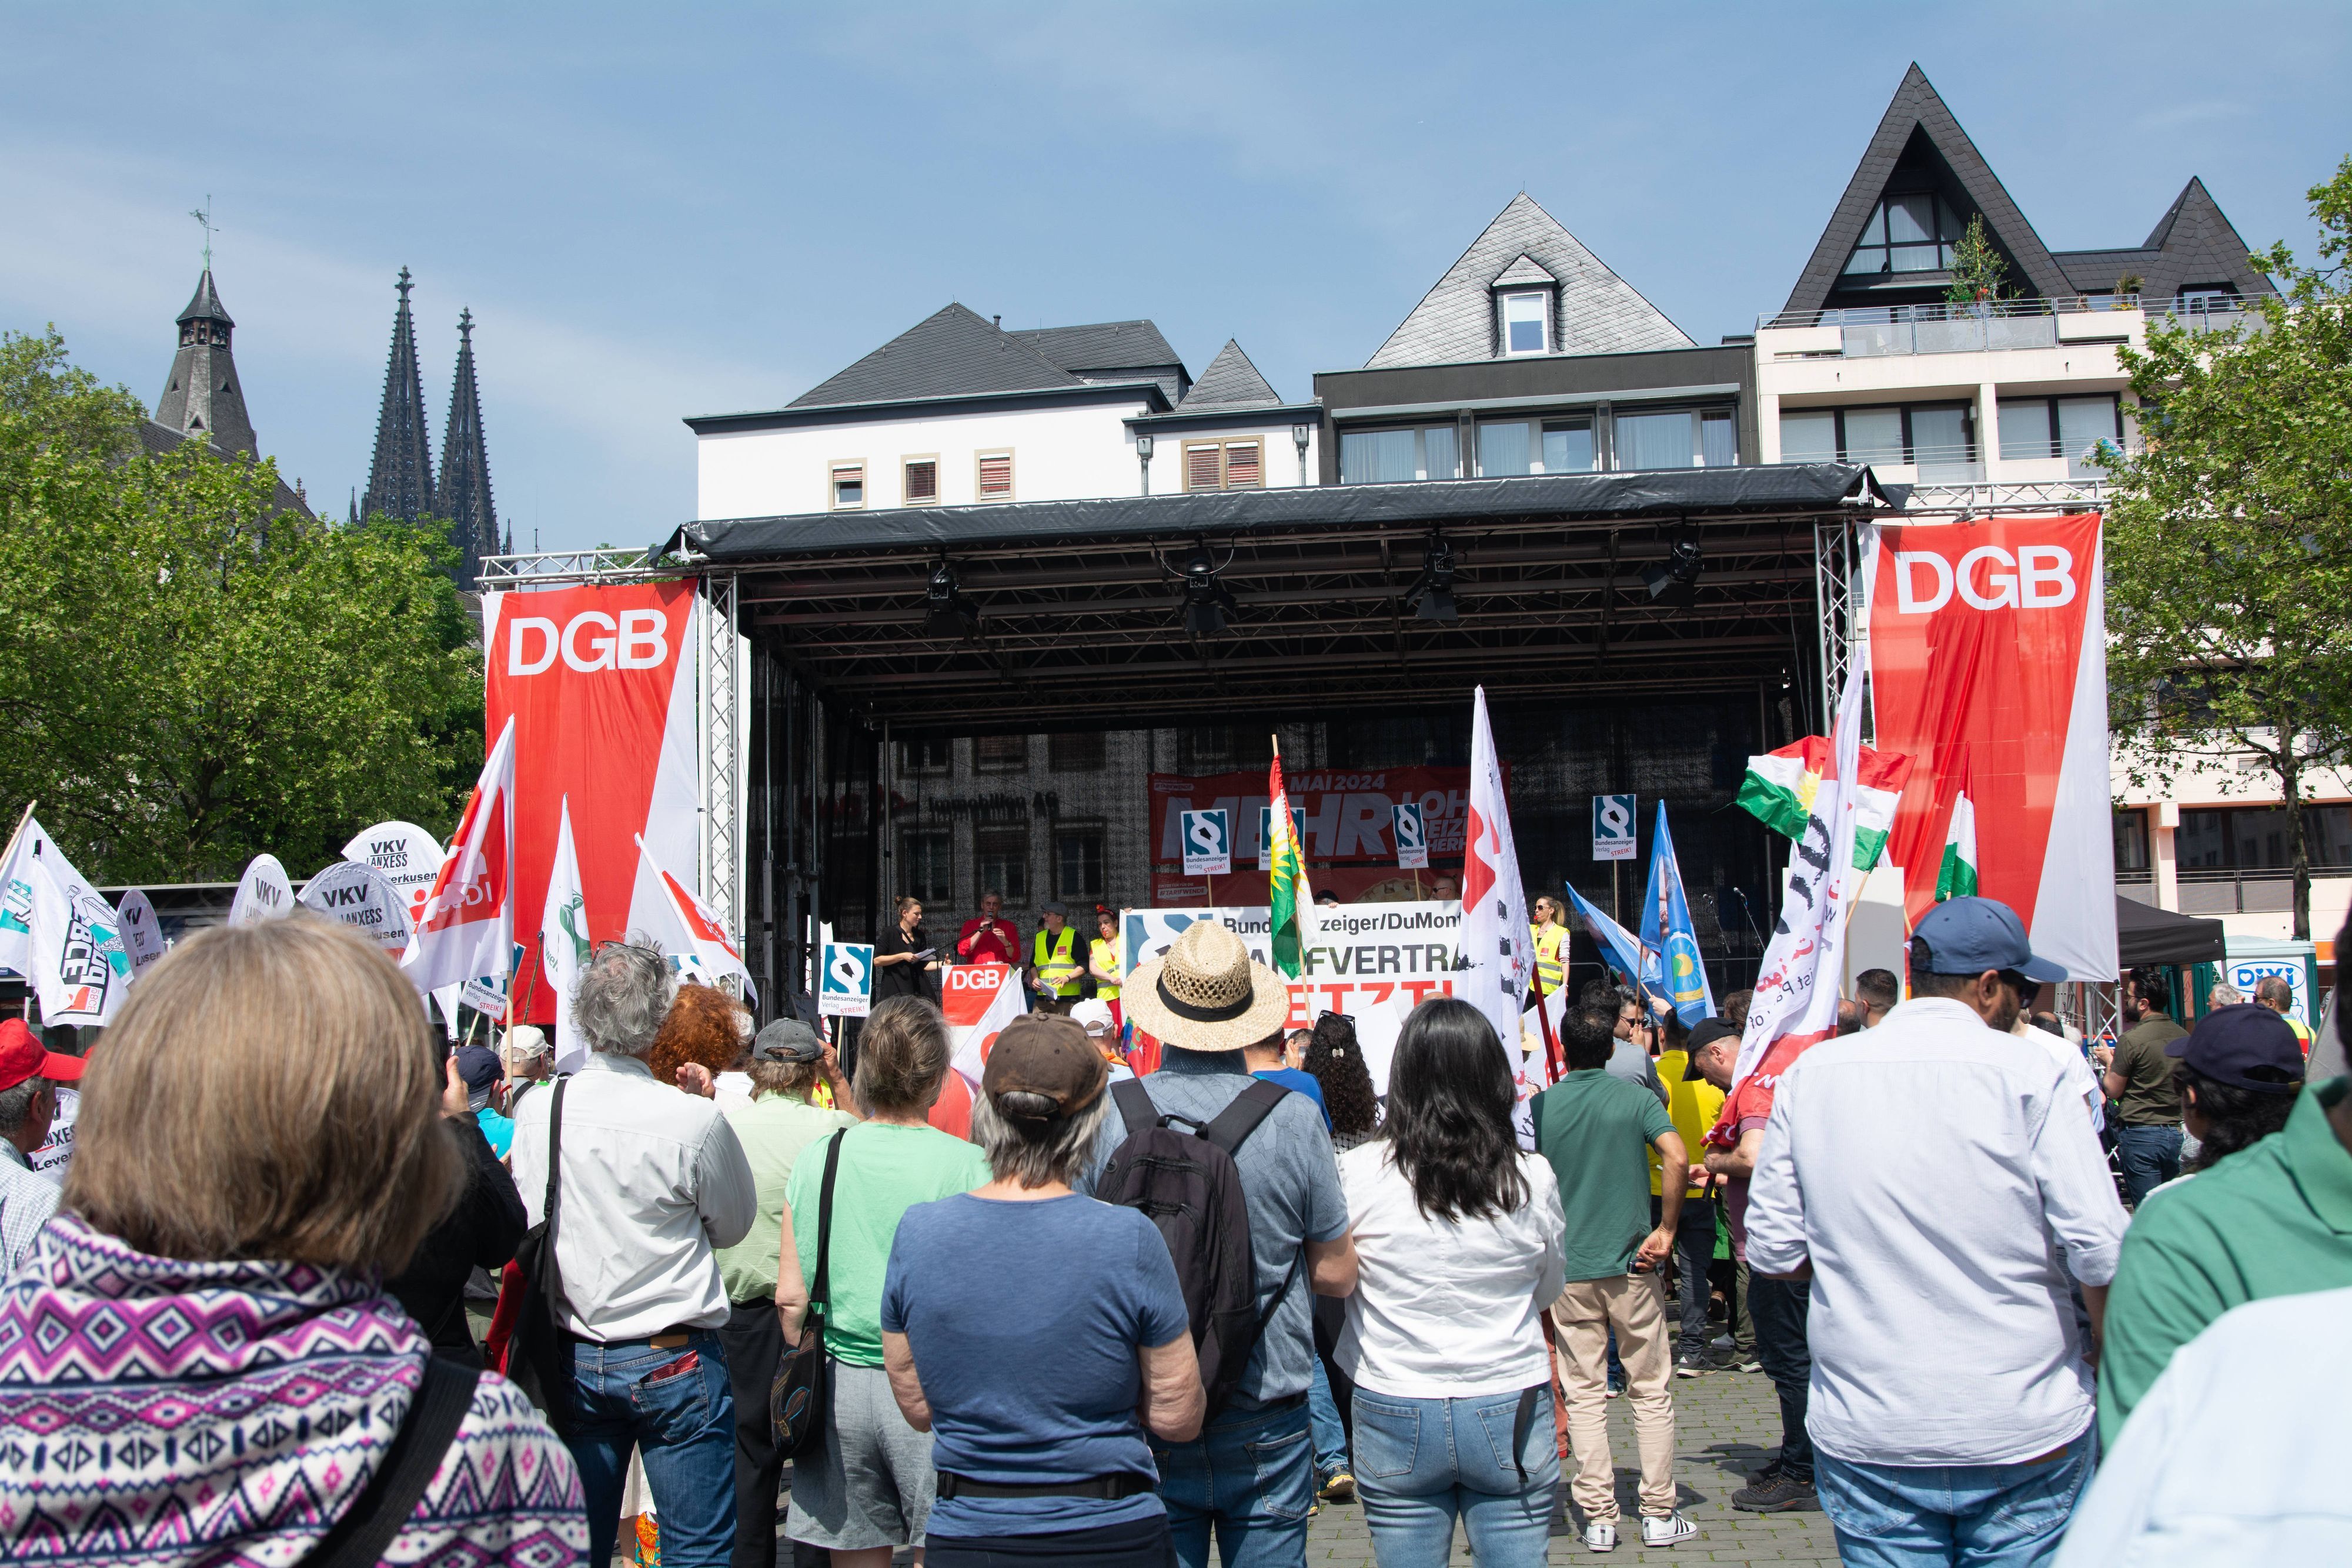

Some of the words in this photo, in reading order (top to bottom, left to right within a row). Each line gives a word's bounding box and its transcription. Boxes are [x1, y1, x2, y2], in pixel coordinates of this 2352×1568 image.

[1894, 546, 2076, 614] DGB
[508, 609, 667, 676] DGB
[1290, 775, 1332, 792] MAI
[1334, 774, 1385, 790] 2024
[370, 839, 407, 854] VKV
[1611, 847, 1632, 857] STREIK!
[366, 854, 408, 869] LANXESS
[1411, 855, 1425, 865] STREIK!
[1203, 862, 1226, 874] STREIK!
[256, 877, 282, 908] VKV
[322, 884, 368, 908] VKV
[1159, 888, 1205, 896] #TARIFWENDE
[952, 969, 1000, 990] DGB
[466, 988, 481, 1002] Verlag
[468, 981, 507, 1004] Bundesanzeiger
[822, 994, 868, 1004] Bundesanzeiger
[479, 1002, 502, 1012] STREIK!
[821, 1001, 839, 1009] Verlag
[840, 1005, 865, 1014] STREIK!
